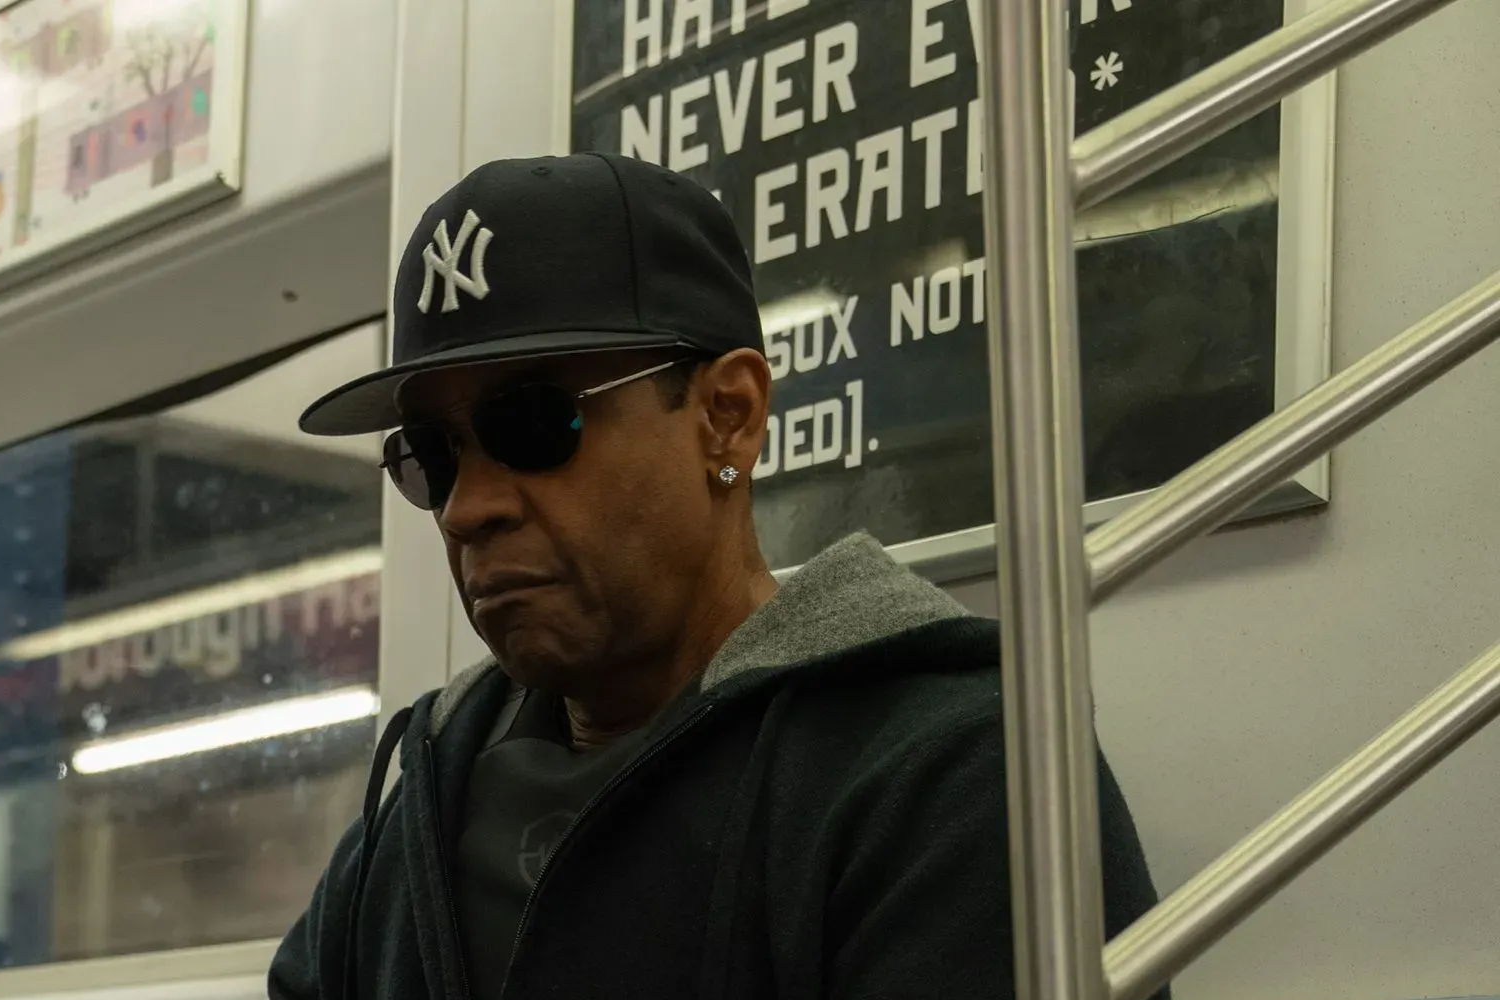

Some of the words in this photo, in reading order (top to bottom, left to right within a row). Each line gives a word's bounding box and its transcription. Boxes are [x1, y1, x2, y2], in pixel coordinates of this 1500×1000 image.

[622, 0, 809, 77] HA
[620, 21, 858, 173] NEVER
[417, 208, 494, 314] NY
[752, 379, 878, 480] DED].
